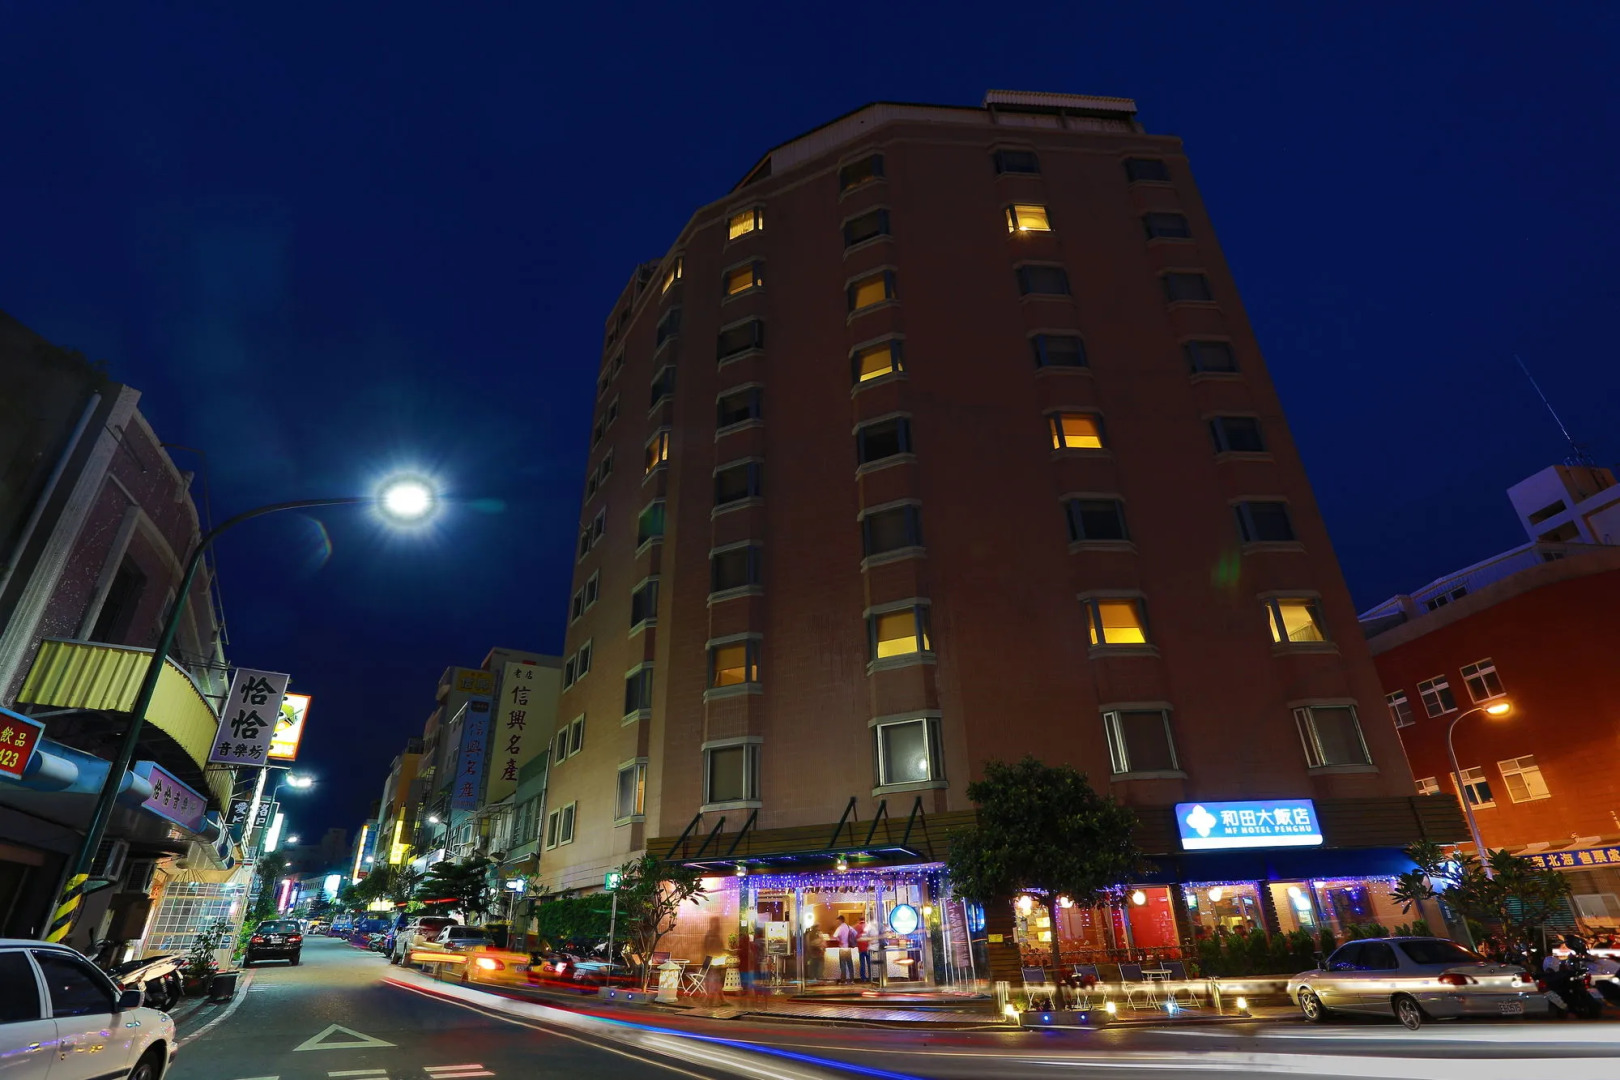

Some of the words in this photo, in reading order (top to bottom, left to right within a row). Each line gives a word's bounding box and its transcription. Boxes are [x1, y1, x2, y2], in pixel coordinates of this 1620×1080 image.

[231, 676, 277, 740] 恰恰
[217, 741, 264, 760] 音樂坊
[1220, 807, 1311, 827] 和田大飯店
[1241, 826, 1271, 834] HOTEL
